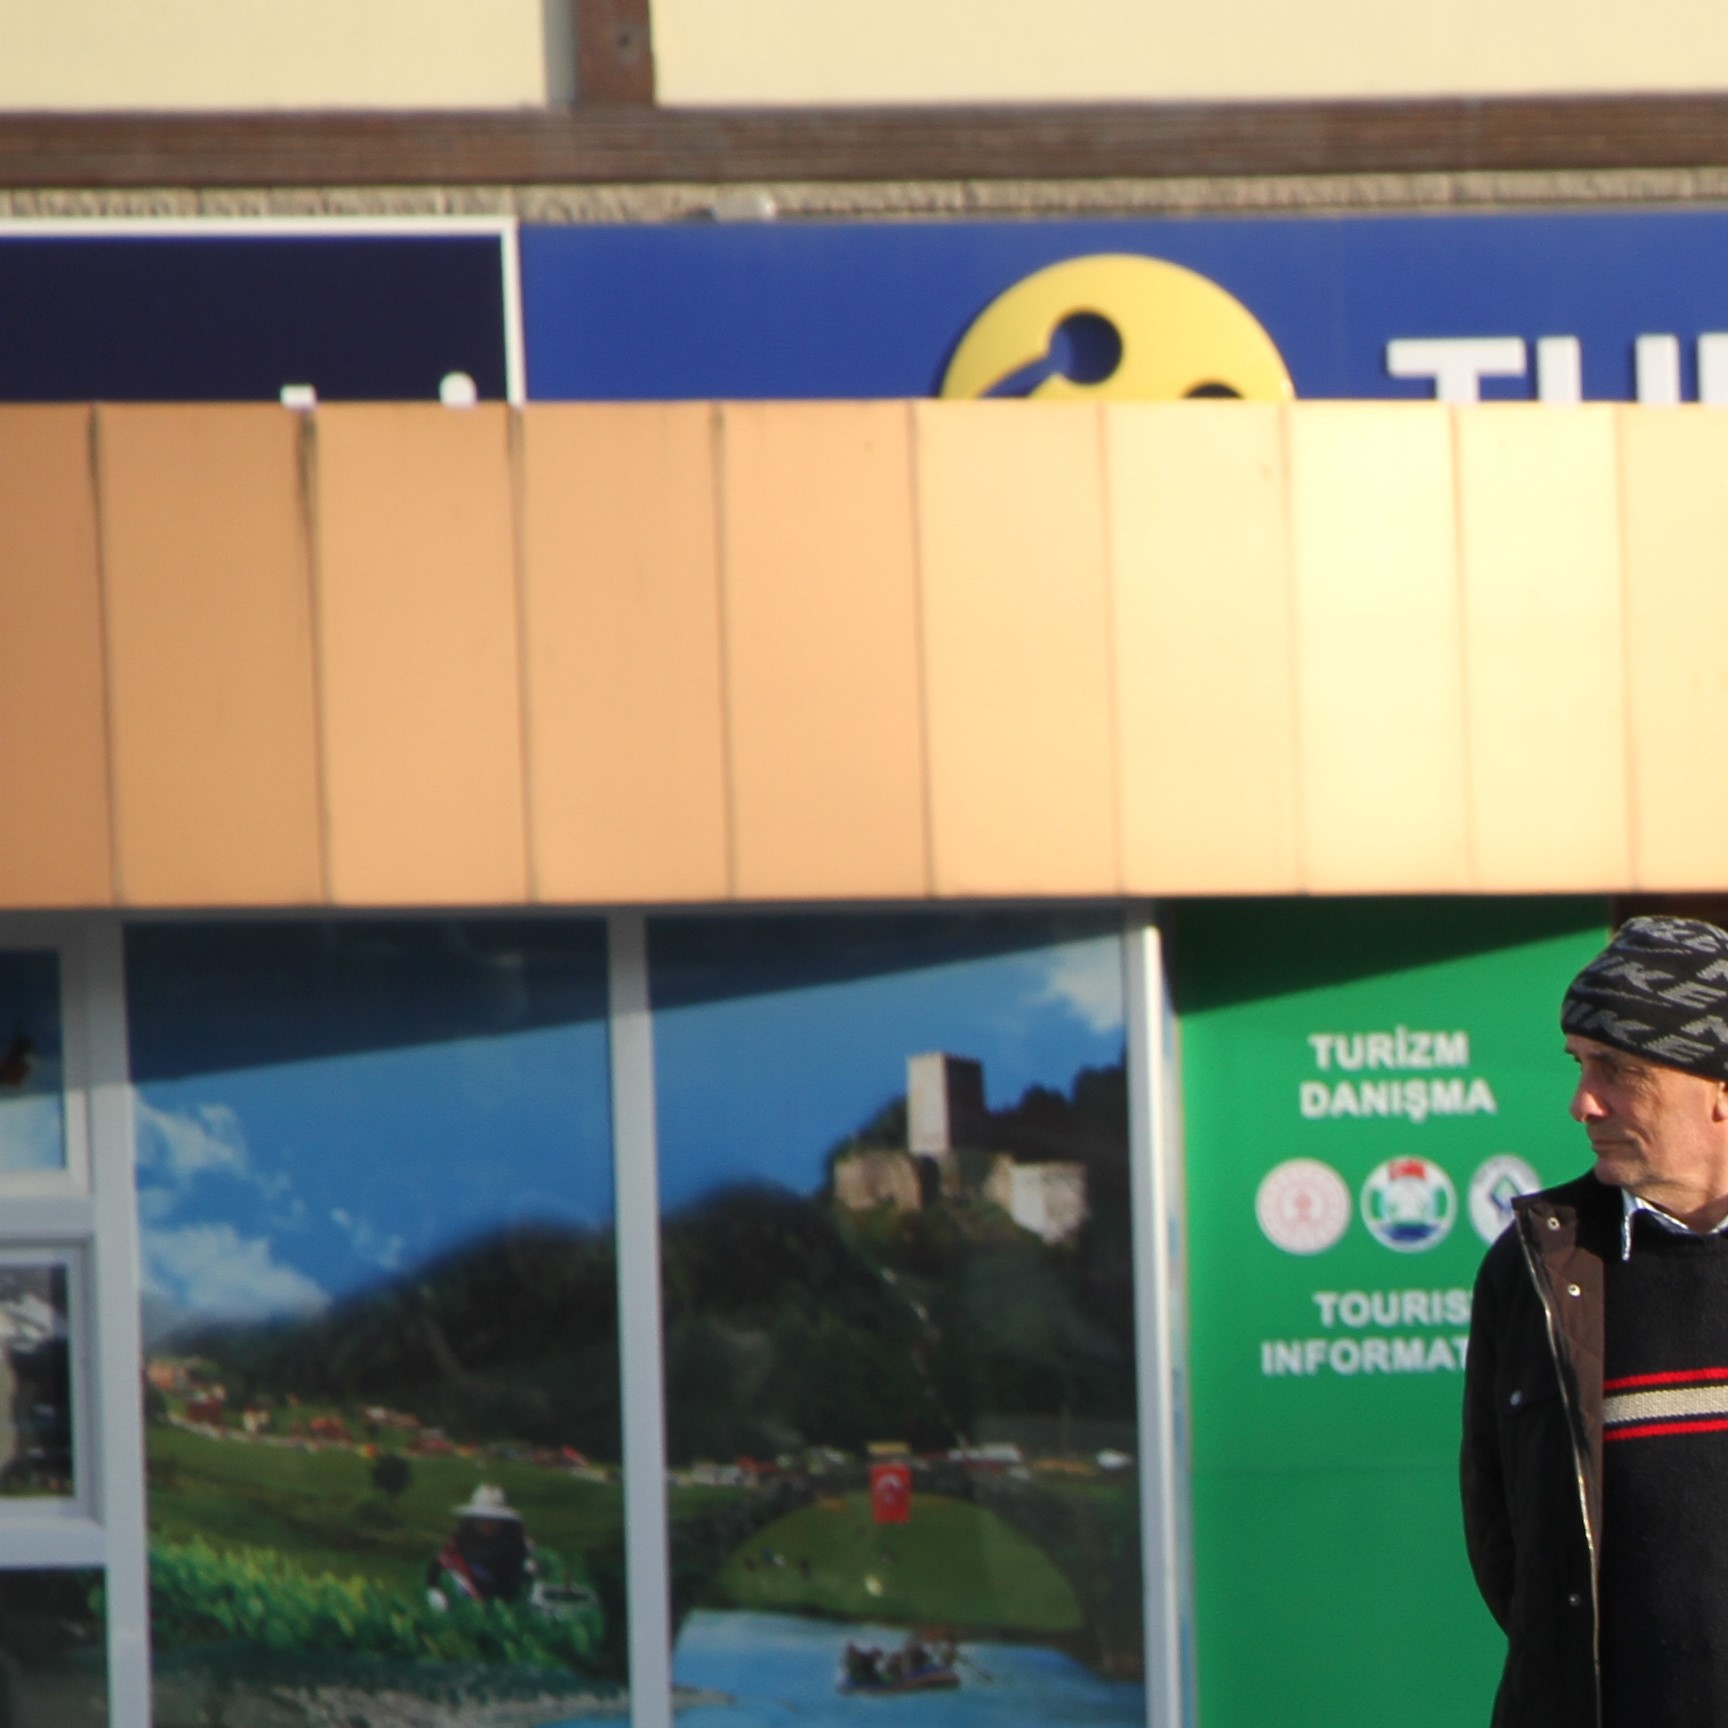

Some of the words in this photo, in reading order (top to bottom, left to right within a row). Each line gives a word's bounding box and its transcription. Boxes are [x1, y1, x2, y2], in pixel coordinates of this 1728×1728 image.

[1308, 1025, 1470, 1070] TURİZM
[1564, 1000, 1715, 1063] IKE
[1299, 1079, 1497, 1123] DANIŞMA
